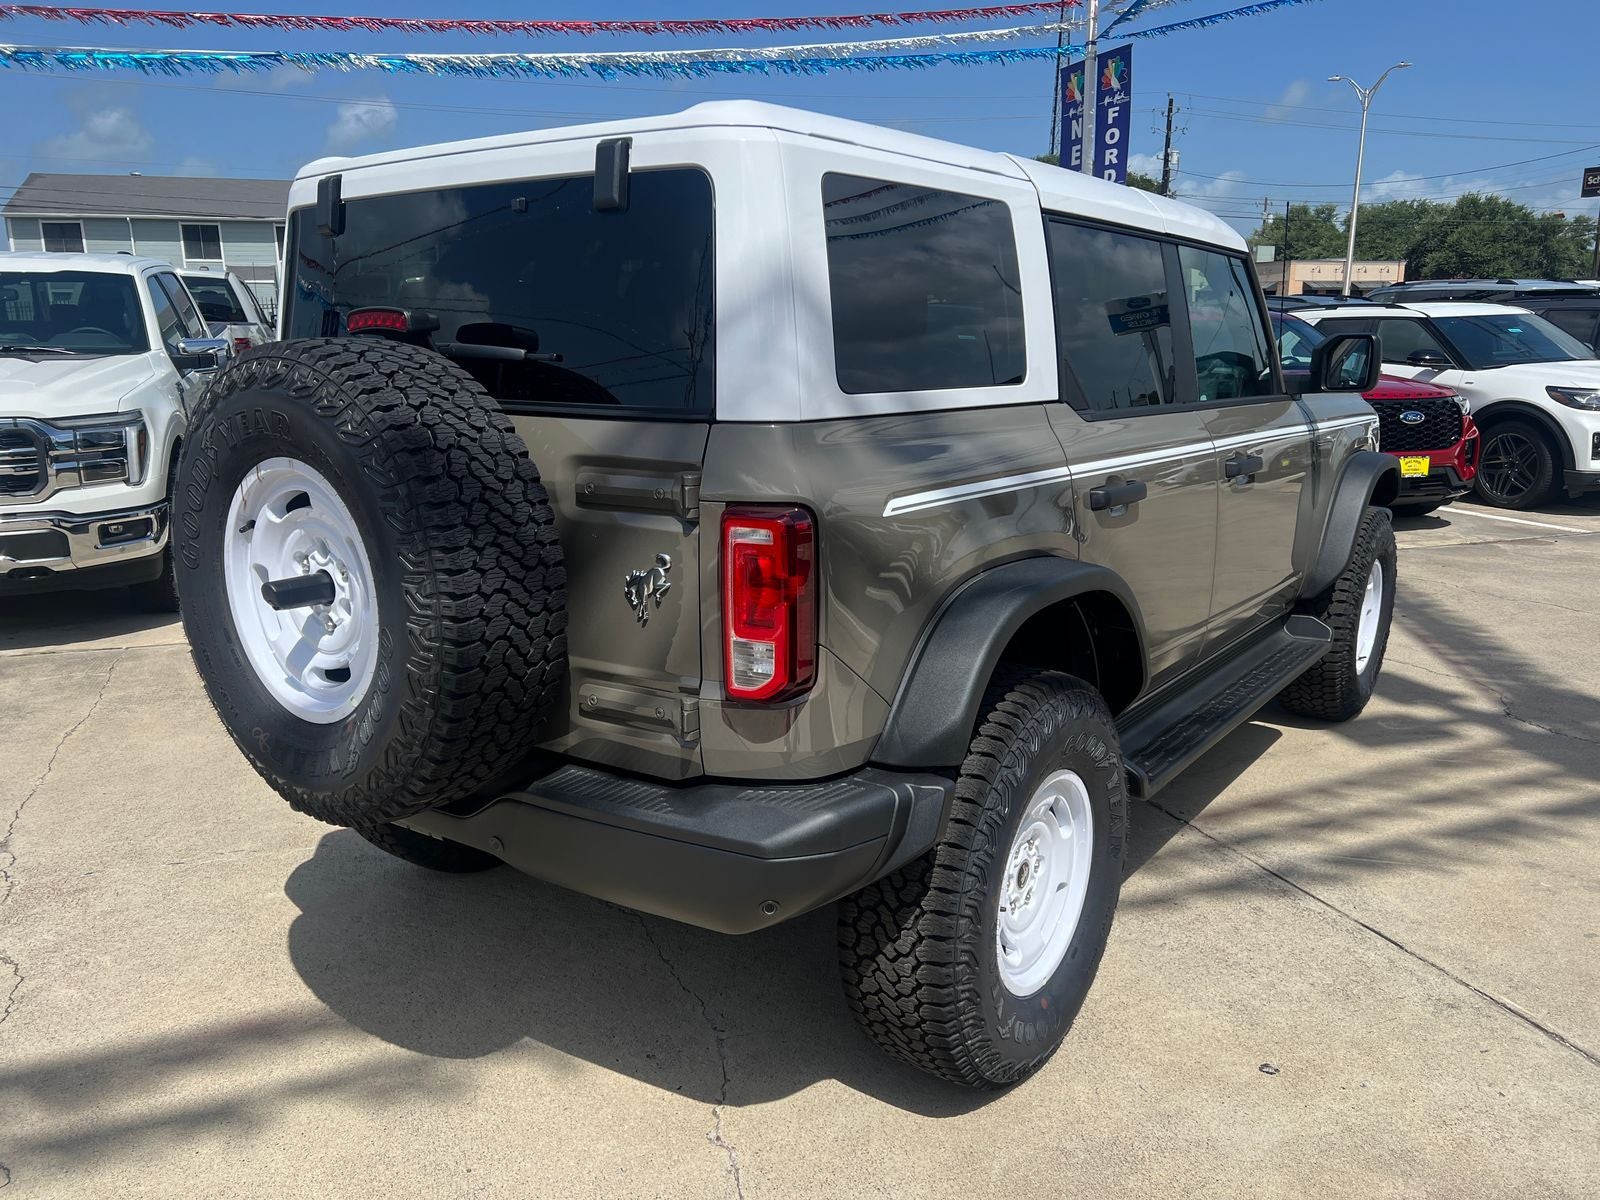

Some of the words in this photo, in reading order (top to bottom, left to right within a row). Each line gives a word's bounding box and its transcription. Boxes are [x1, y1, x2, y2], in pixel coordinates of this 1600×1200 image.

[1071, 117, 1083, 173] NE
[1103, 106, 1121, 183] FORD
[181, 406, 293, 570] GOODYEAR
